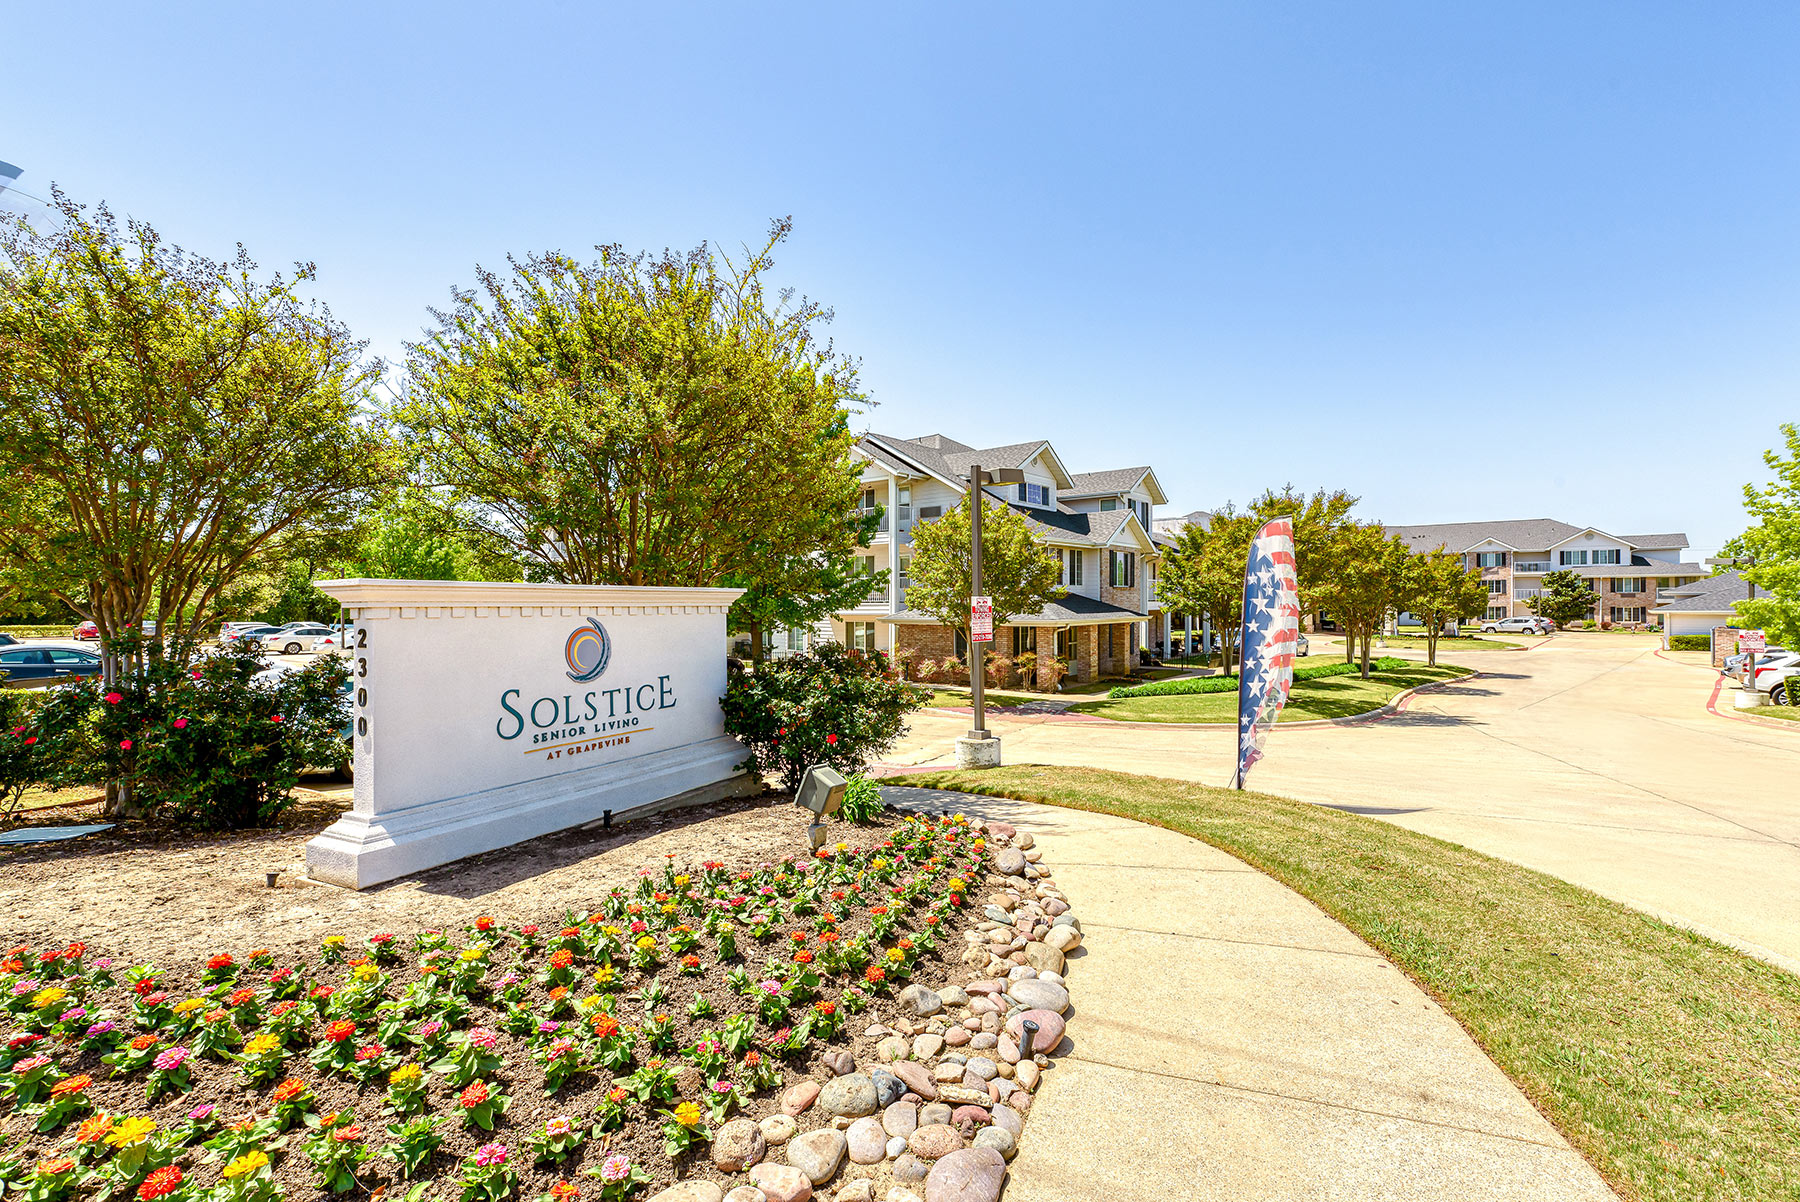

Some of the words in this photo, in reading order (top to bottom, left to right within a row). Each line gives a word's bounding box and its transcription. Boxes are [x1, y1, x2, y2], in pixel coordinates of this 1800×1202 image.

[357, 628, 368, 737] 2300
[496, 674, 678, 740] SOLSTICE
[533, 726, 586, 744] SENIOR
[594, 717, 639, 733] LIVING
[546, 750, 562, 760] AT
[567, 736, 631, 755] GRAPEVINE
